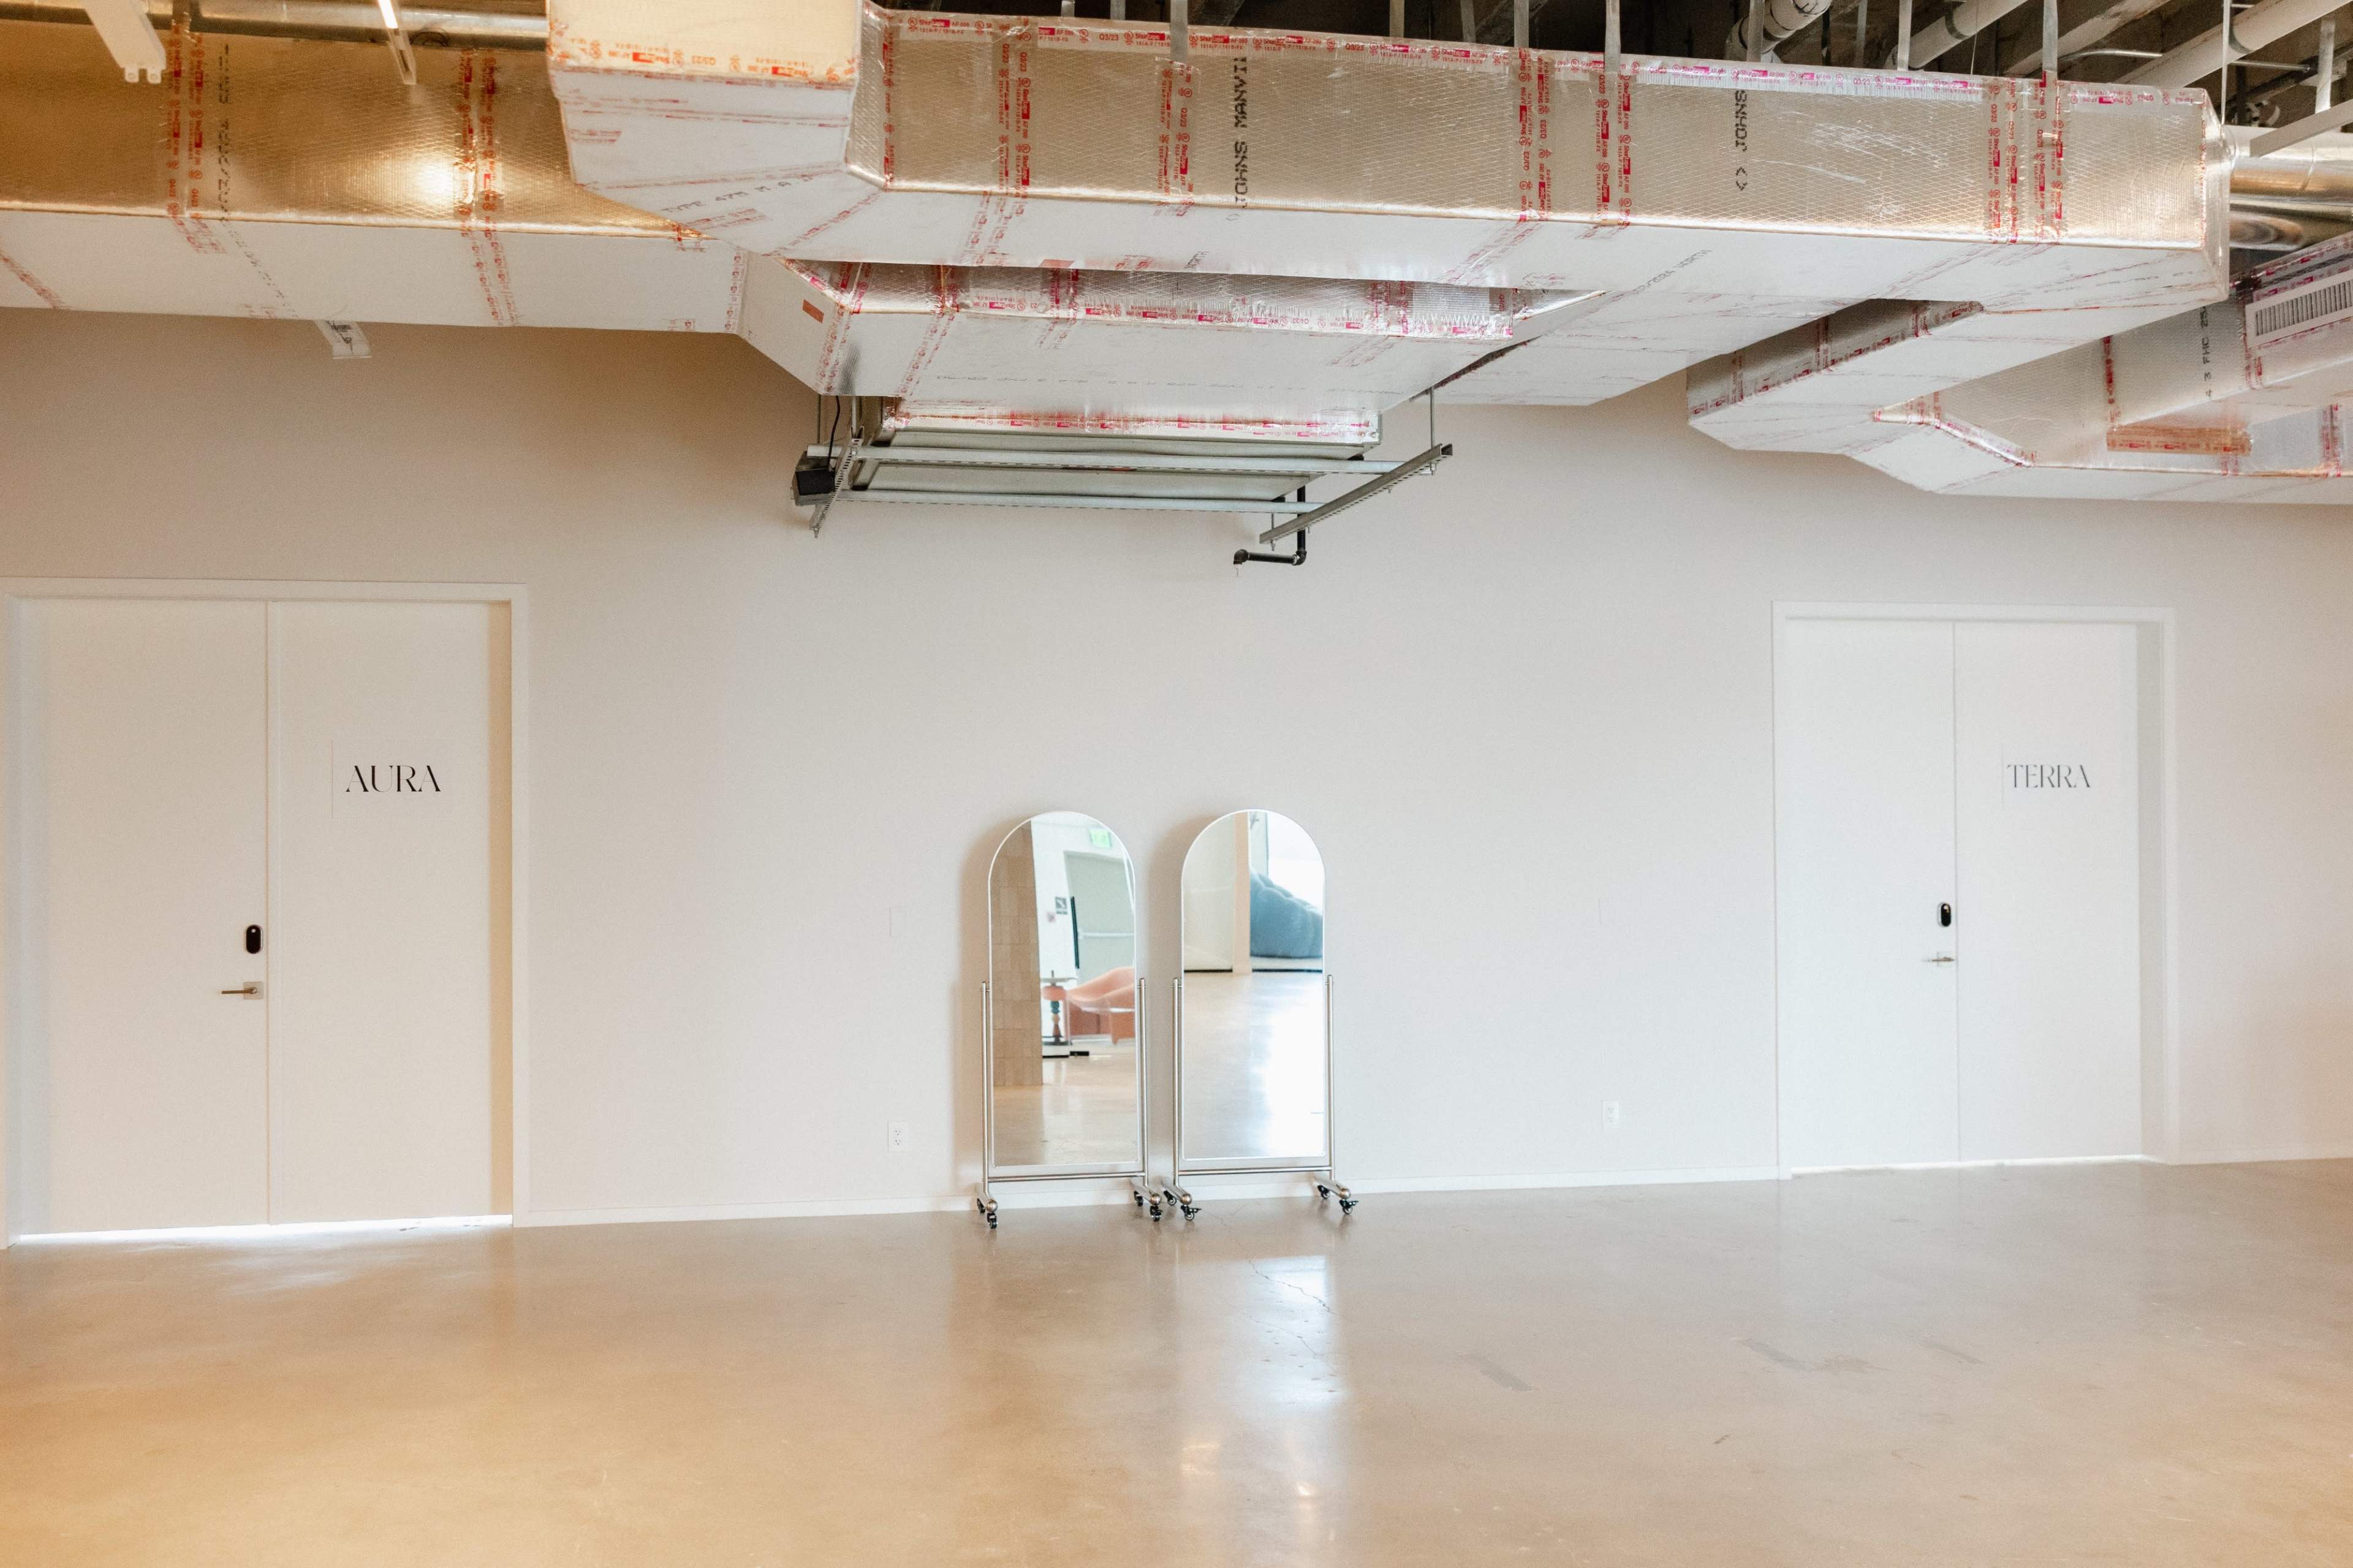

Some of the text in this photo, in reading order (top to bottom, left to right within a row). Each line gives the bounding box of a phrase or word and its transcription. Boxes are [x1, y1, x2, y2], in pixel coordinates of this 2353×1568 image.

[1734, 90, 1748, 152] JOHNS
[1234, 141, 1248, 209] JOHNS
[2202, 338, 2210, 365] FHC
[346, 765, 441, 792] AURA
[2006, 764, 2091, 788] TERRA
